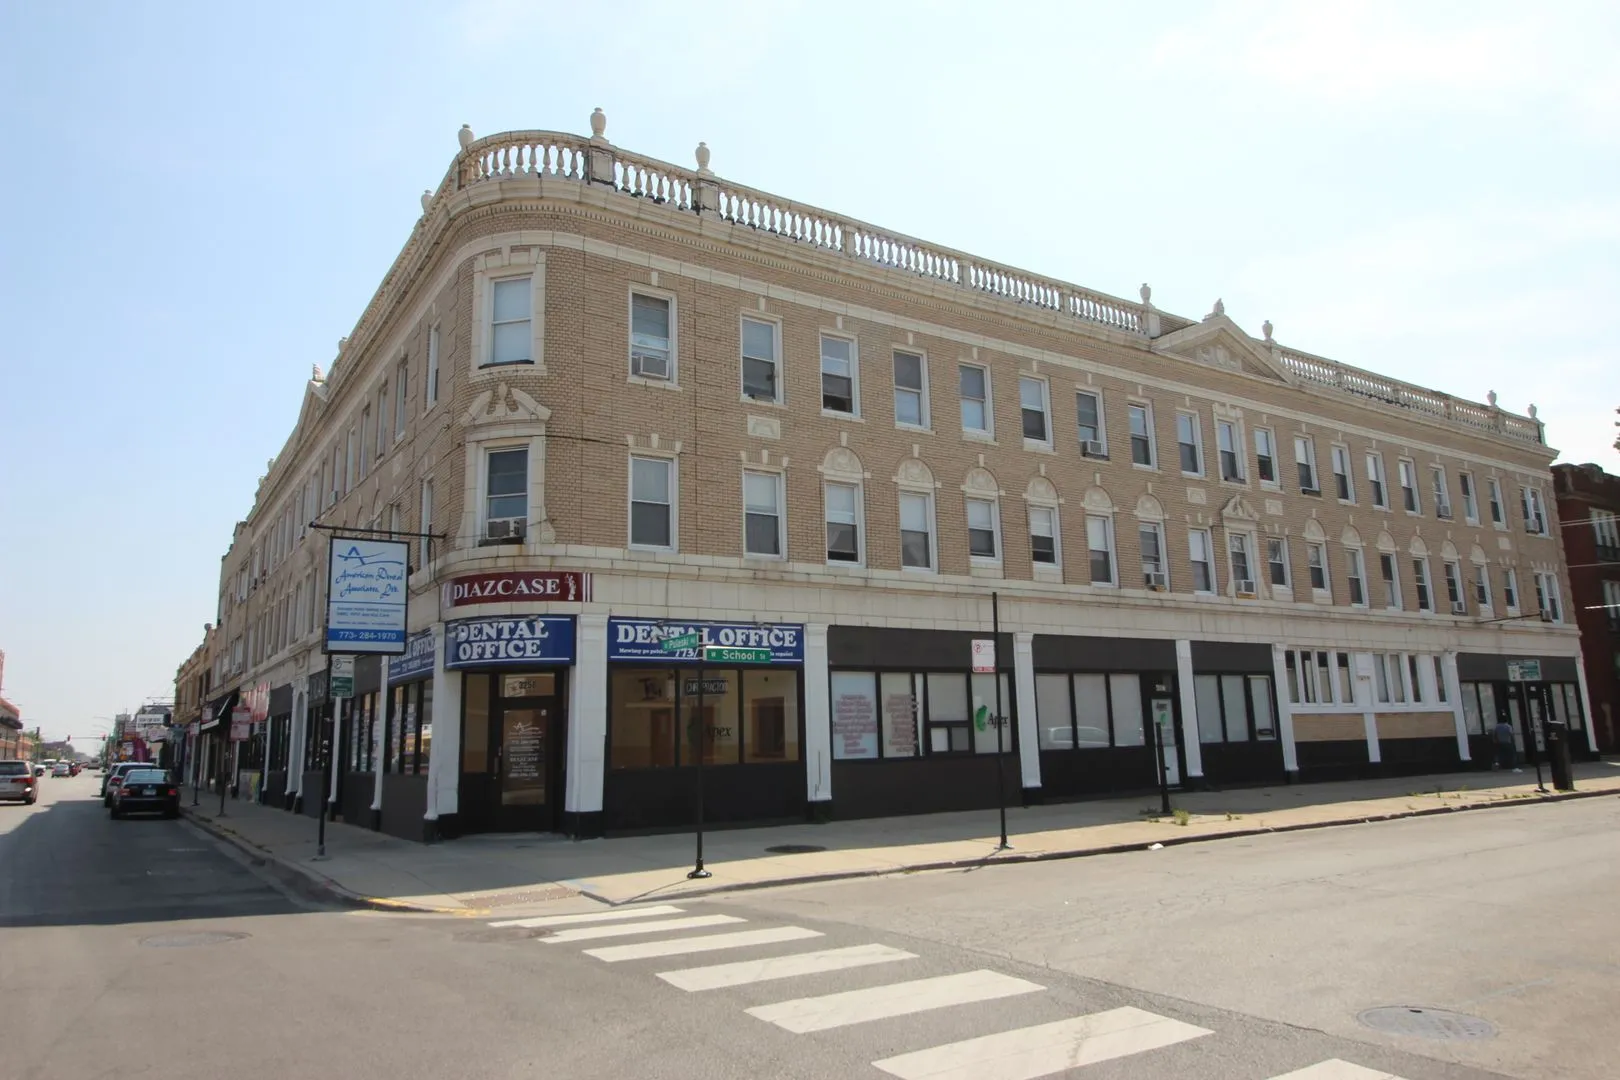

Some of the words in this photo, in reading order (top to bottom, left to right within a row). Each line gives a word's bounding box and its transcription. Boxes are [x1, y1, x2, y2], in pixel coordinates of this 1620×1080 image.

[335, 569, 375, 584] American
[376, 567, 404, 581] Dental
[453, 579, 560, 600] DIAZCASE
[455, 619, 549, 640] DENTAL
[616, 624, 715, 646] DENTAL
[719, 628, 797, 648] OFFICE
[458, 640, 542, 660] OFFICE
[710, 650, 717, 658] W
[722, 649, 756, 661] School
[759, 652, 766, 660] St
[686, 681, 728, 694] CHIRPRACTOR
